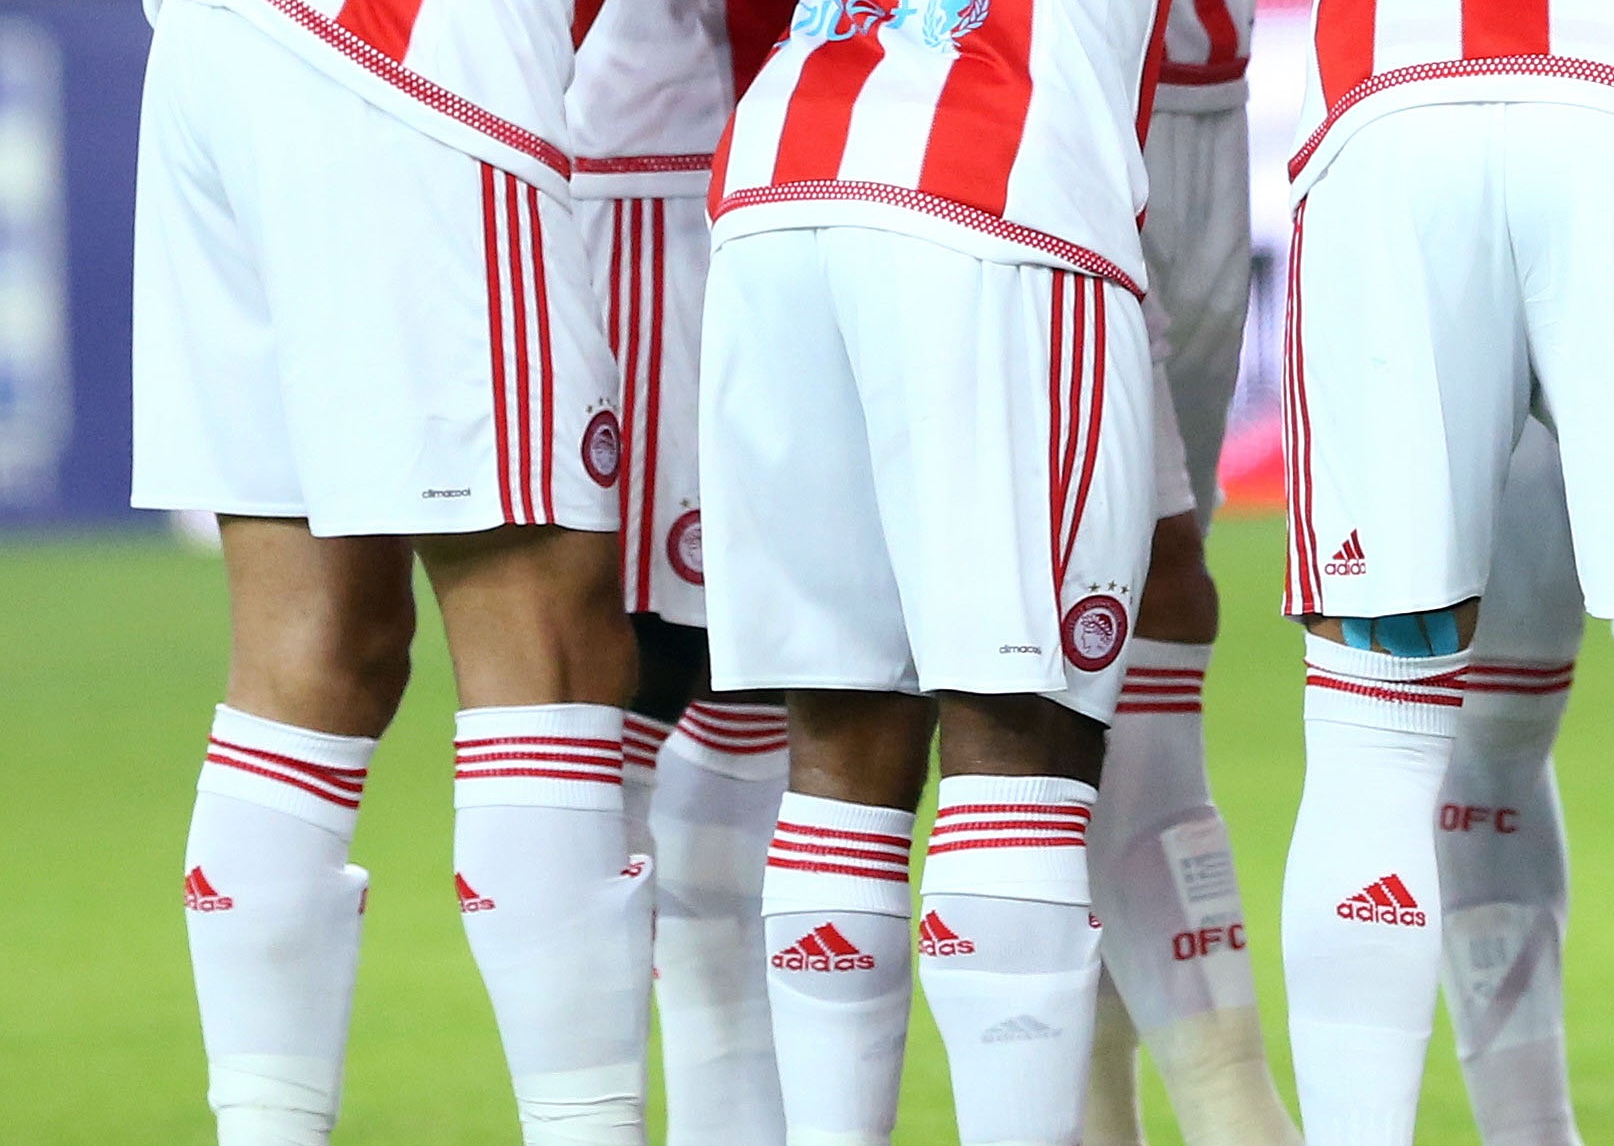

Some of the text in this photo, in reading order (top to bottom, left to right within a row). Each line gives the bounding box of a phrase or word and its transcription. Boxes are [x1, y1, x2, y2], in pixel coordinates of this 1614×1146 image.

[1440, 803, 1520, 834] OFC
[1336, 901, 1426, 927] adidas
[1172, 923, 1248, 961] OFC
[771, 953, 876, 972] adidas
